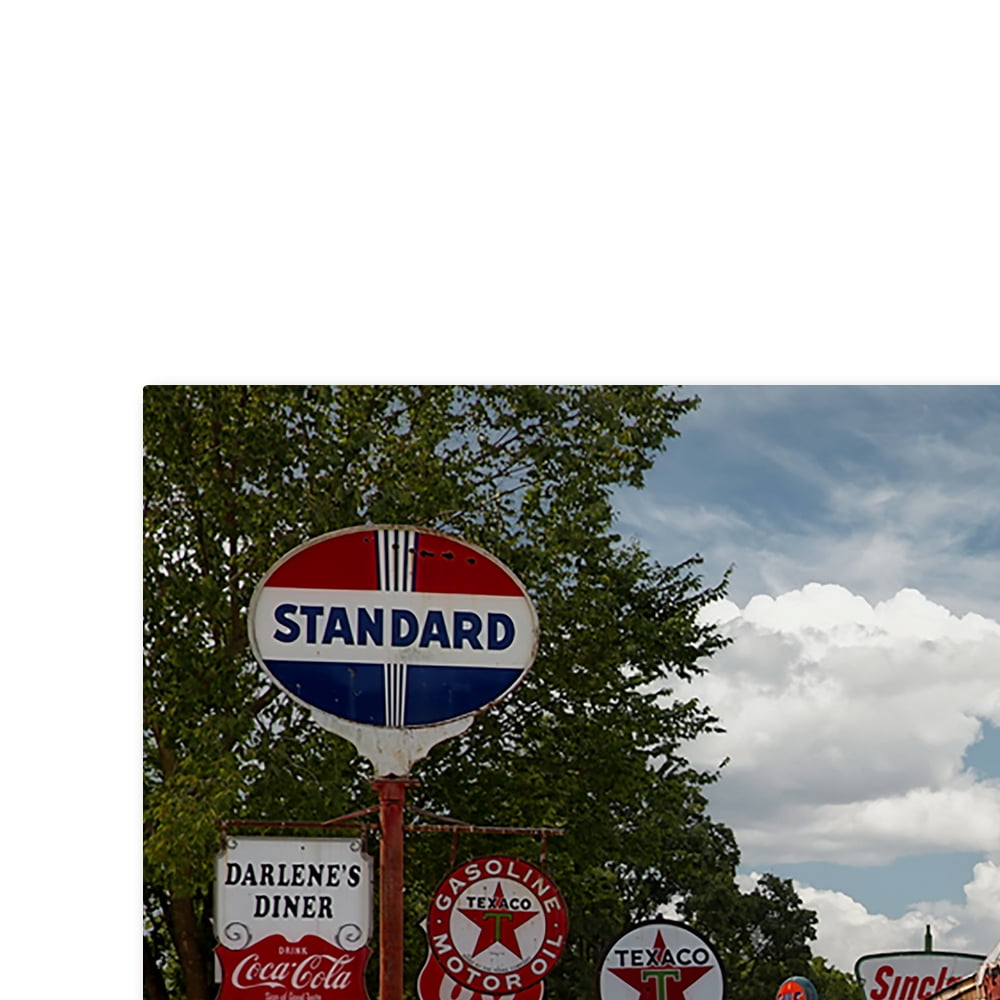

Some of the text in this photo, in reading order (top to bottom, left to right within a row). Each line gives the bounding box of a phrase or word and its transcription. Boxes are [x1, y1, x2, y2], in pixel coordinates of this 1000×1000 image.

[273, 603, 516, 651] STANDARD
[225, 862, 361, 887] DARLENE'S
[435, 859, 561, 913] GASOLINE
[254, 895, 333, 919] DINER
[466, 896, 531, 910] TEXACO
[278, 946, 308, 955] DRINK
[433, 933, 523, 992] MOTOR
[530, 934, 563, 976] OIL
[614, 947, 710, 967] TEXACO
[231, 953, 355, 989] Coca-Cola
